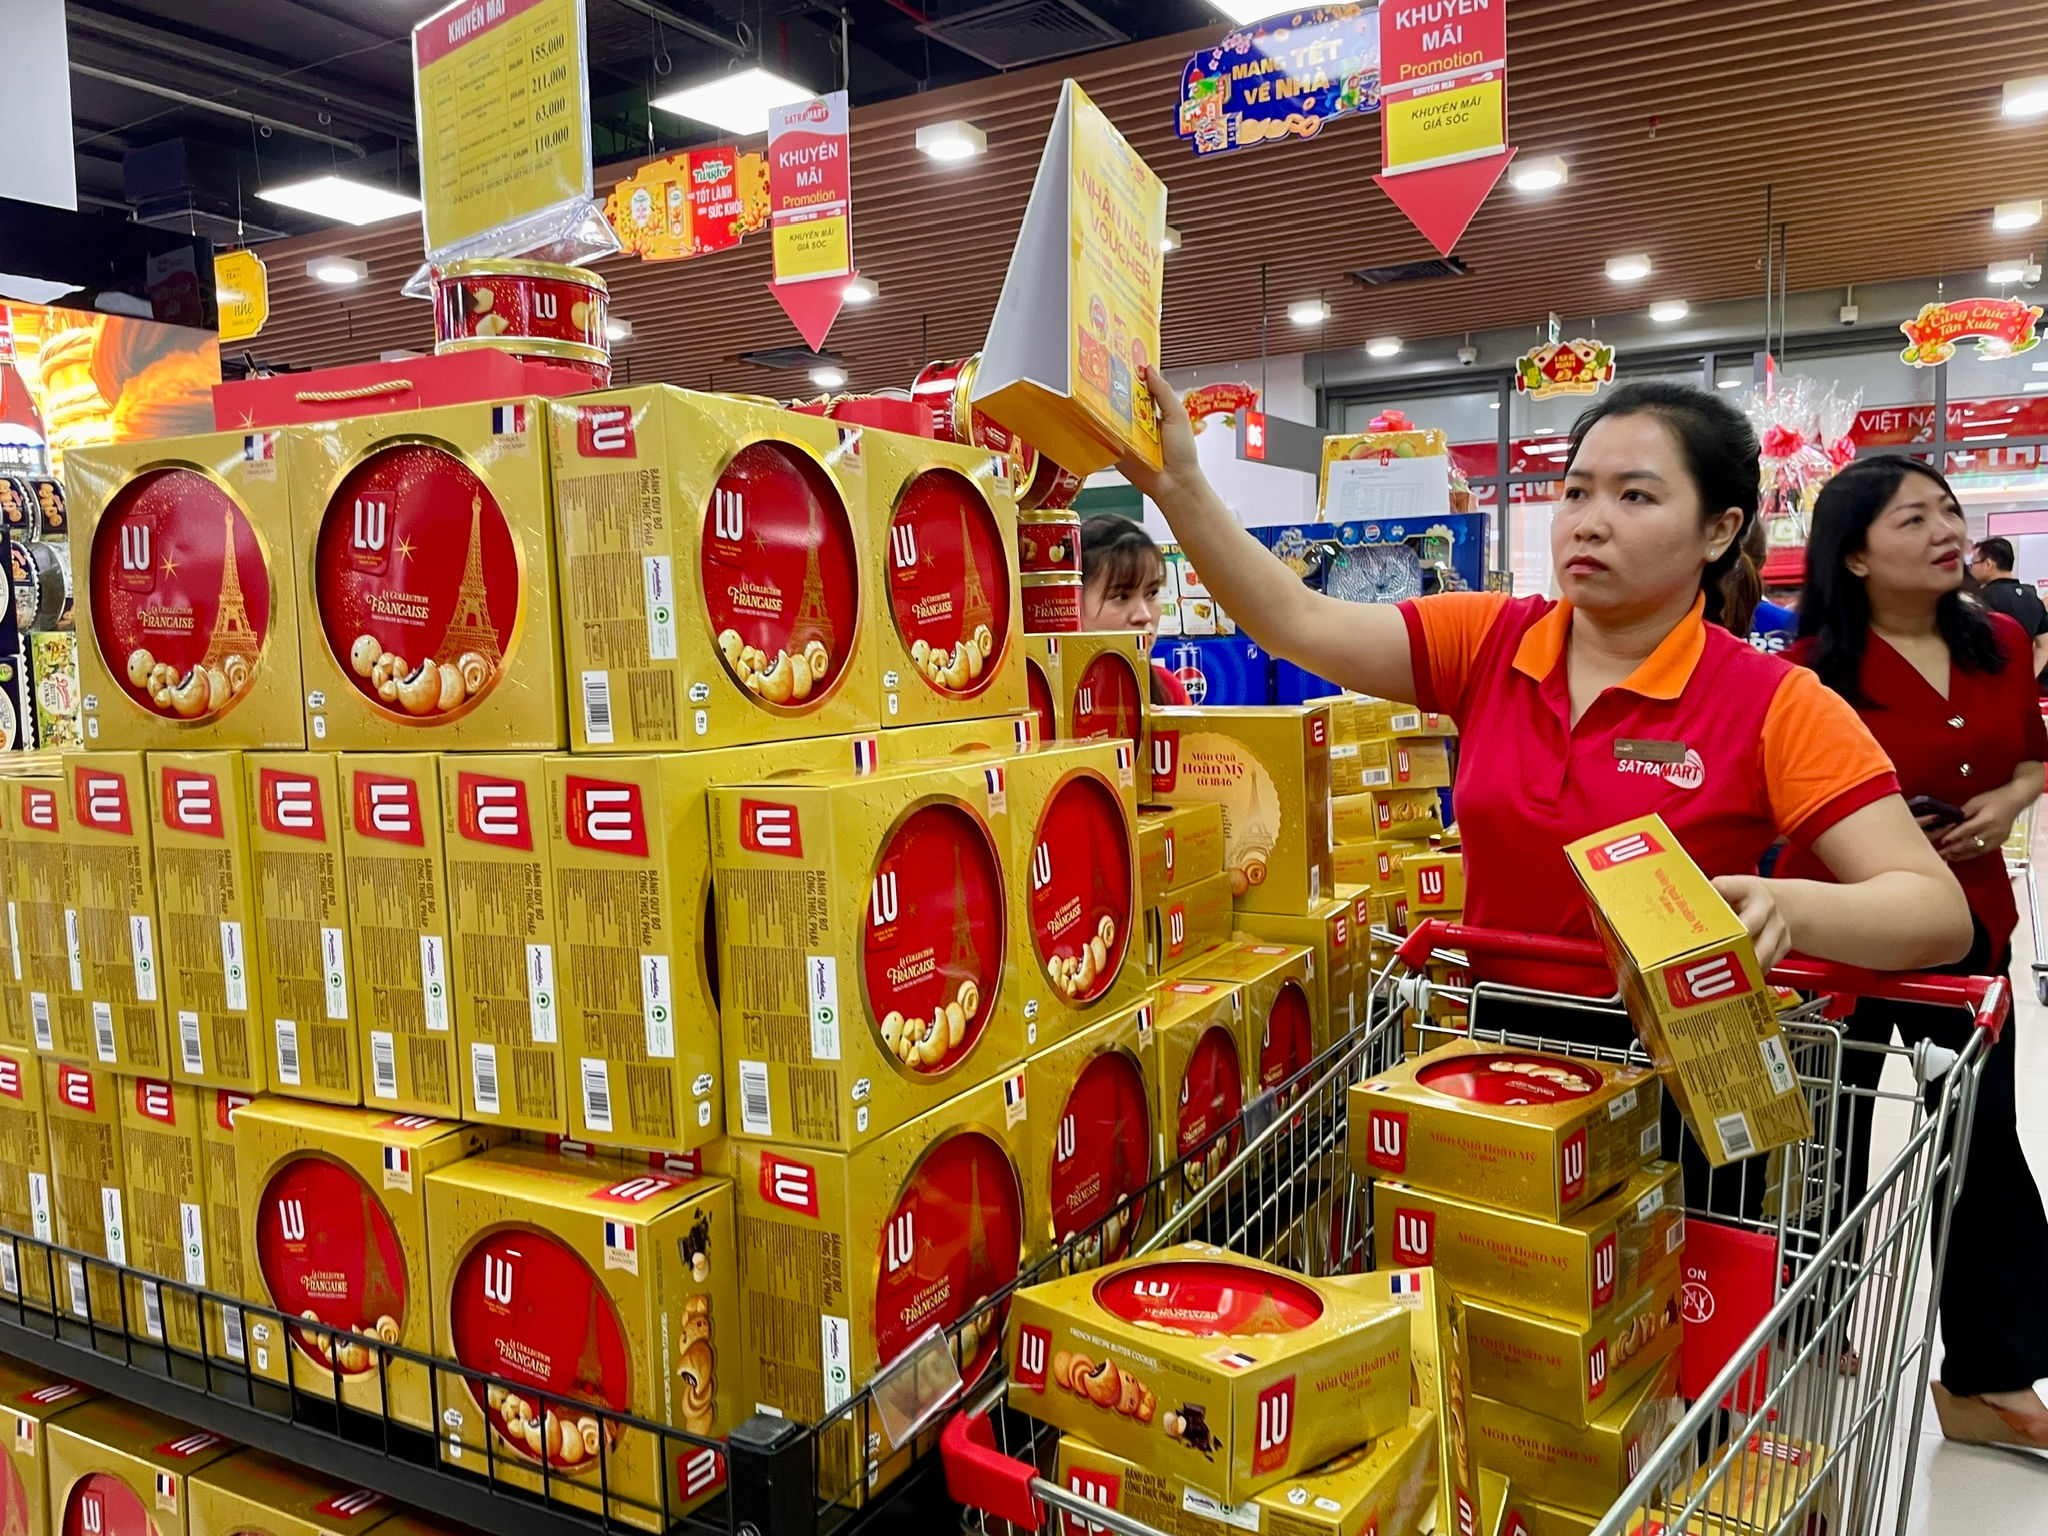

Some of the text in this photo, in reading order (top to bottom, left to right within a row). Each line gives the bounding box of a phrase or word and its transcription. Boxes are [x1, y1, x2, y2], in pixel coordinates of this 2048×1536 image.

[530, 33, 564, 65] 155,000
[1422, 24, 1462, 52] MÃI
[1232, 37, 1343, 81] MANG TẾT
[1400, 50, 1483, 80] Promotion
[532, 64, 567, 95] 211,000
[1244, 67, 1330, 105] VỀ NHÀ
[535, 96, 566, 123] 63,000
[779, 141, 838, 169] KHUYẾN
[796, 167, 822, 188] MÃI
[782, 190, 836, 208] Promotion
[534, 292, 557, 320] LU
[1965, 318, 2000, 332] Xuân
[593, 410, 626, 451] LU
[1860, 410, 1902, 433] VIỆT
[354, 498, 387, 551] LU
[715, 487, 744, 542] LU
[121, 524, 150, 570] LU
[892, 522, 917, 568] LU
[1078, 687, 1092, 716] LU
[1313, 720, 1324, 742] LU
[1152, 740, 1172, 776] U
[1617, 759, 1700, 781] SATRAMART
[30, 794, 52, 825] LU
[88, 778, 122, 825] LU
[176, 780, 212, 825] LU
[276, 781, 314, 827] LU
[370, 784, 411, 832] LU
[476, 784, 519, 836] LU
[584, 789, 632, 842] LU
[1379, 803, 1390, 822] LU
[755, 808, 792, 848] LU
[1032, 841, 1051, 891] LU
[1604, 834, 1650, 863] LU
[648, 870, 658, 895] BÁNH
[816, 870, 826, 895] BÁNH
[872, 870, 898, 926] LU
[1421, 870, 1442, 894] LU
[638, 870, 652, 946] CÔNG THỨC PHÁP
[650, 896, 660, 916] QUY
[806, 870, 819, 946] CÔNG THỨC PHÁP
[817, 896, 828, 916] QUY
[1170, 910, 1184, 946] LU
[1685, 956, 1736, 998] LU
[66, 1073, 90, 1105] LU
[146, 1084, 168, 1116] LU
[1056, 1114, 1076, 1163] LU
[1372, 1116, 1400, 1156] LU
[1564, 1140, 1582, 1185] LU
[774, 1163, 809, 1206] LU
[279, 1199, 305, 1240] LU
[1398, 1214, 1427, 1255] LU
[888, 1211, 914, 1273] LU
[485, 1254, 513, 1304] LU
[1596, 1244, 1614, 1290] LU
[1133, 1280, 1170, 1297] LU
[1022, 1331, 1046, 1375] LU
[1590, 1348, 1604, 1387] LU
[1260, 1392, 1288, 1452] LU
[686, 1448, 716, 1496] LU
[1628, 1440, 1639, 1480] LU
[82, 1495, 100, 1534] LU
[1071, 1475, 1108, 1532] LU
